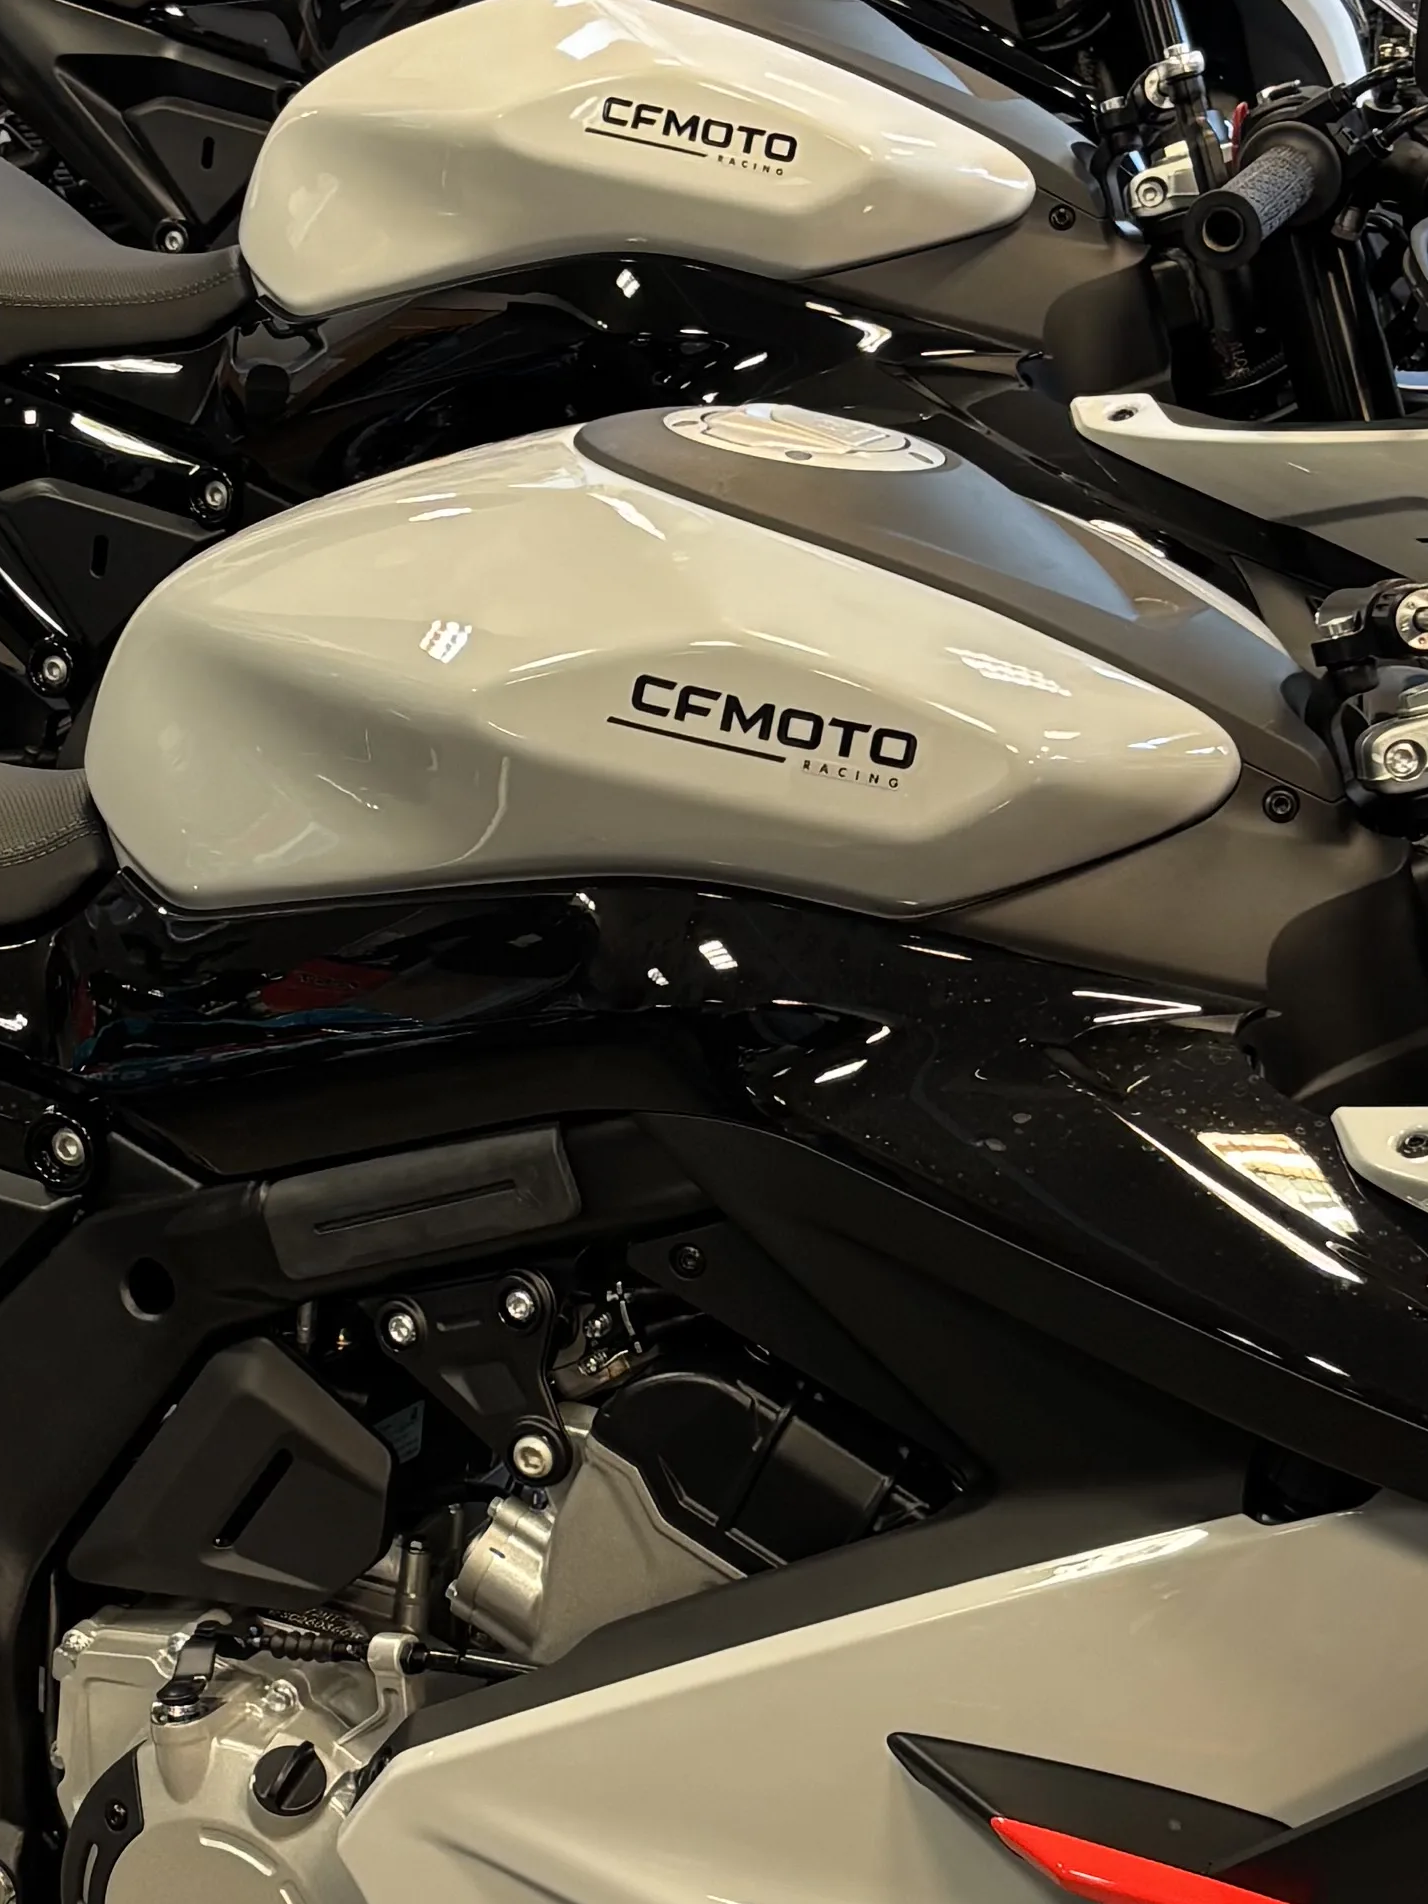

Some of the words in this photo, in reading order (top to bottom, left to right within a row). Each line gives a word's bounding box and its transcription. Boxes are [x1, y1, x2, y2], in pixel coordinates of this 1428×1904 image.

[602, 96, 798, 165] CFMOTO
[718, 155, 784, 177] RACING
[631, 673, 918, 770] CFMOTO
[802, 759, 900, 789] RACING
